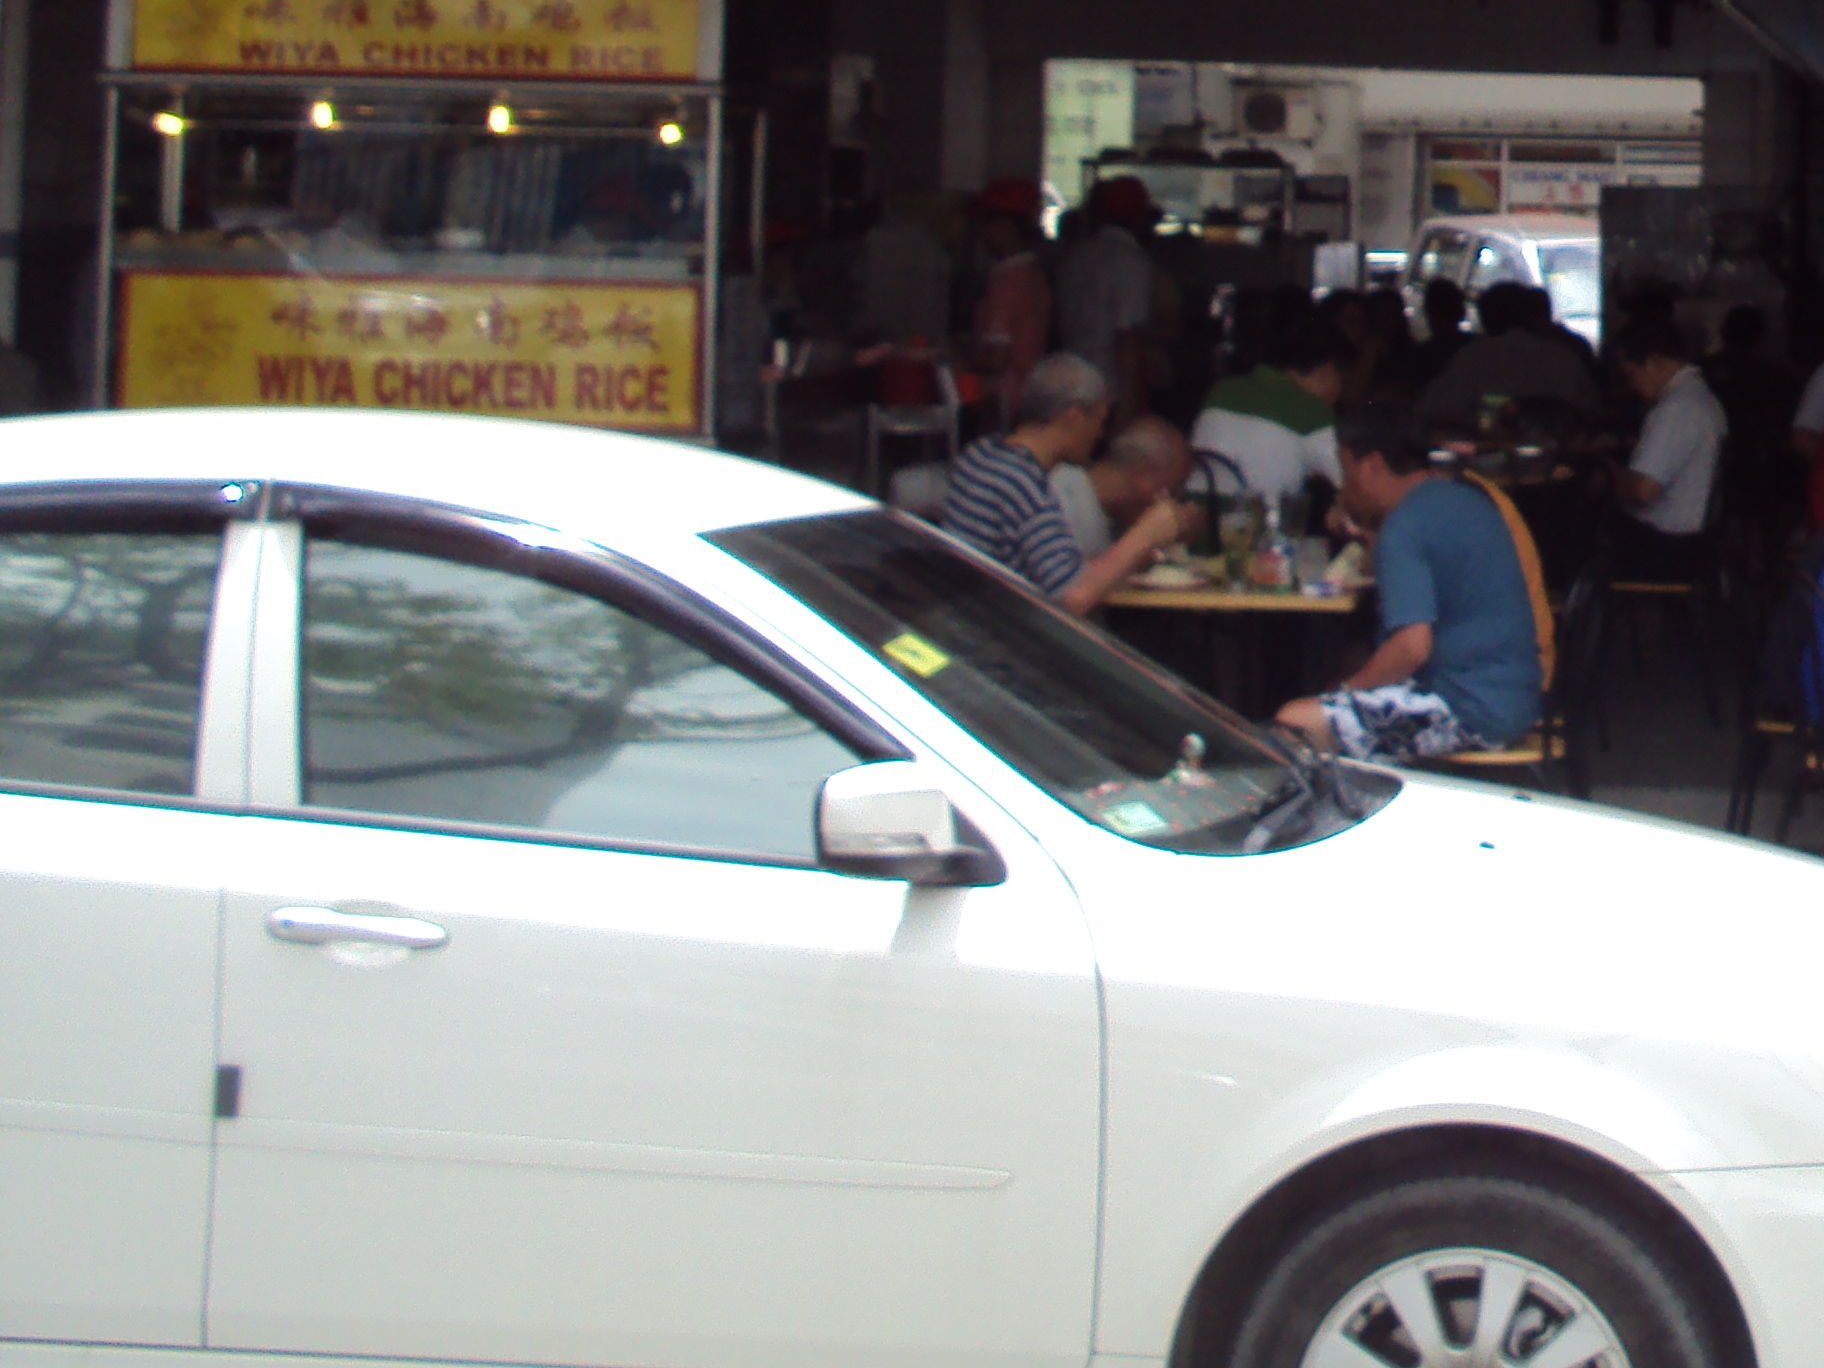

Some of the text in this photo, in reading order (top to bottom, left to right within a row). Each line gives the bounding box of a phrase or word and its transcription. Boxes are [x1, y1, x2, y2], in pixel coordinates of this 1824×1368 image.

[239, 40, 665, 72] WIYA CHICKEN RICE
[257, 353, 670, 414] WIYA CHICKEN RICE
